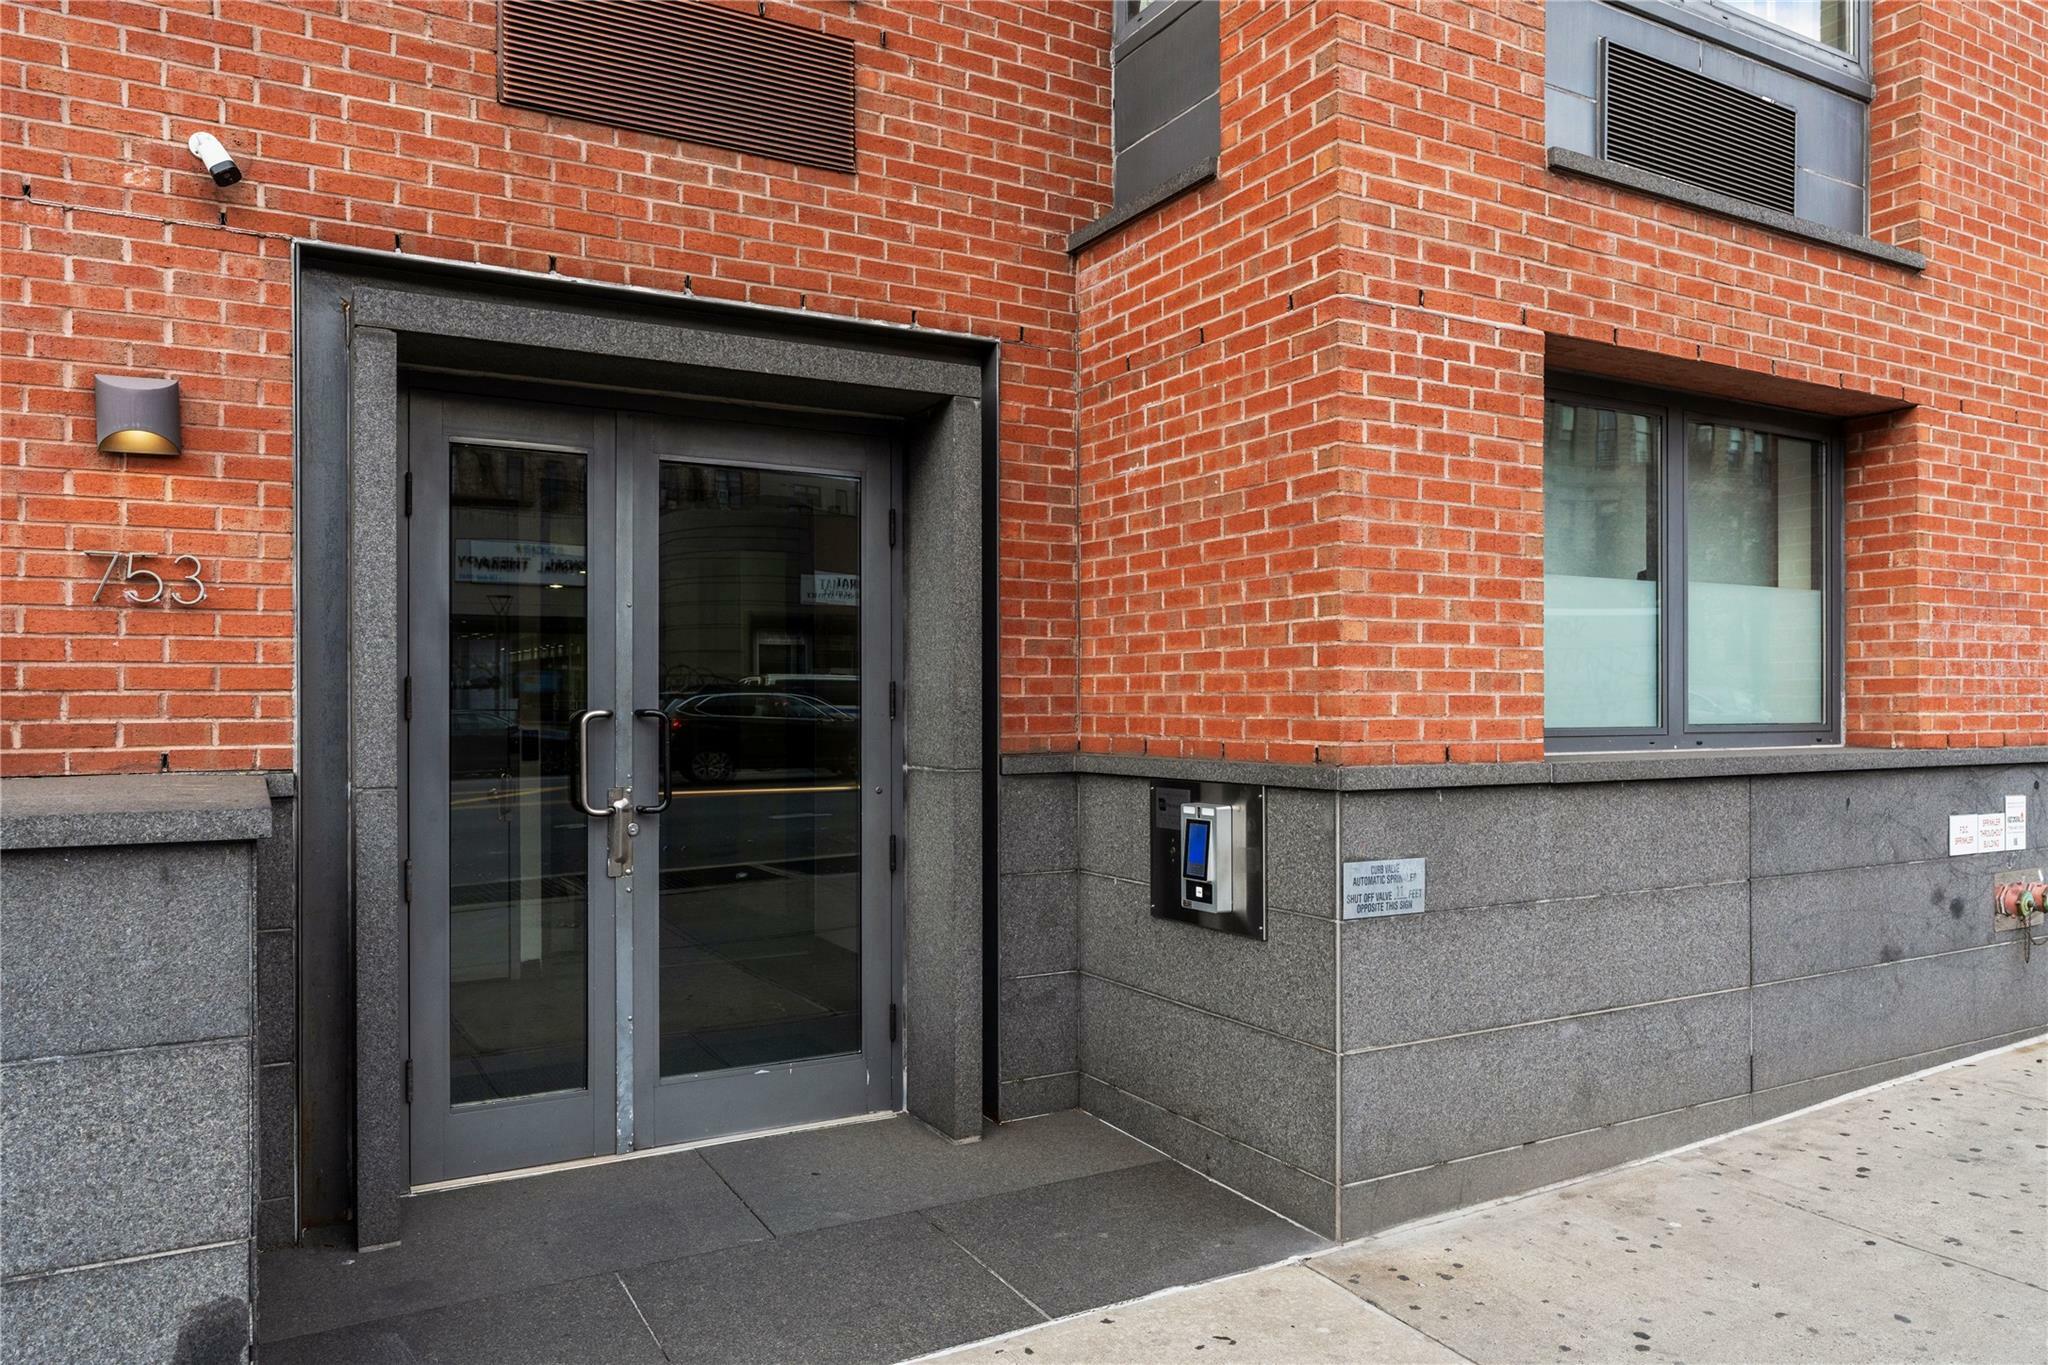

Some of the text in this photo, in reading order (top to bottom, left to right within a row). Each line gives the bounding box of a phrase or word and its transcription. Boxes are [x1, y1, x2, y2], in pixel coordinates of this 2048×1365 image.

[80, 550, 207, 605] 753
[1371, 865, 1384, 875] CURB
[1353, 876, 1386, 886] AUTOMATIC
[1346, 894, 1362, 904] SHUT
[1364, 893, 1374, 903] OFF
[1376, 892, 1392, 901] VALVE
[1408, 888, 1422, 899] FEET
[1357, 900, 1413, 913] OPPOSITE THIS SIGN
